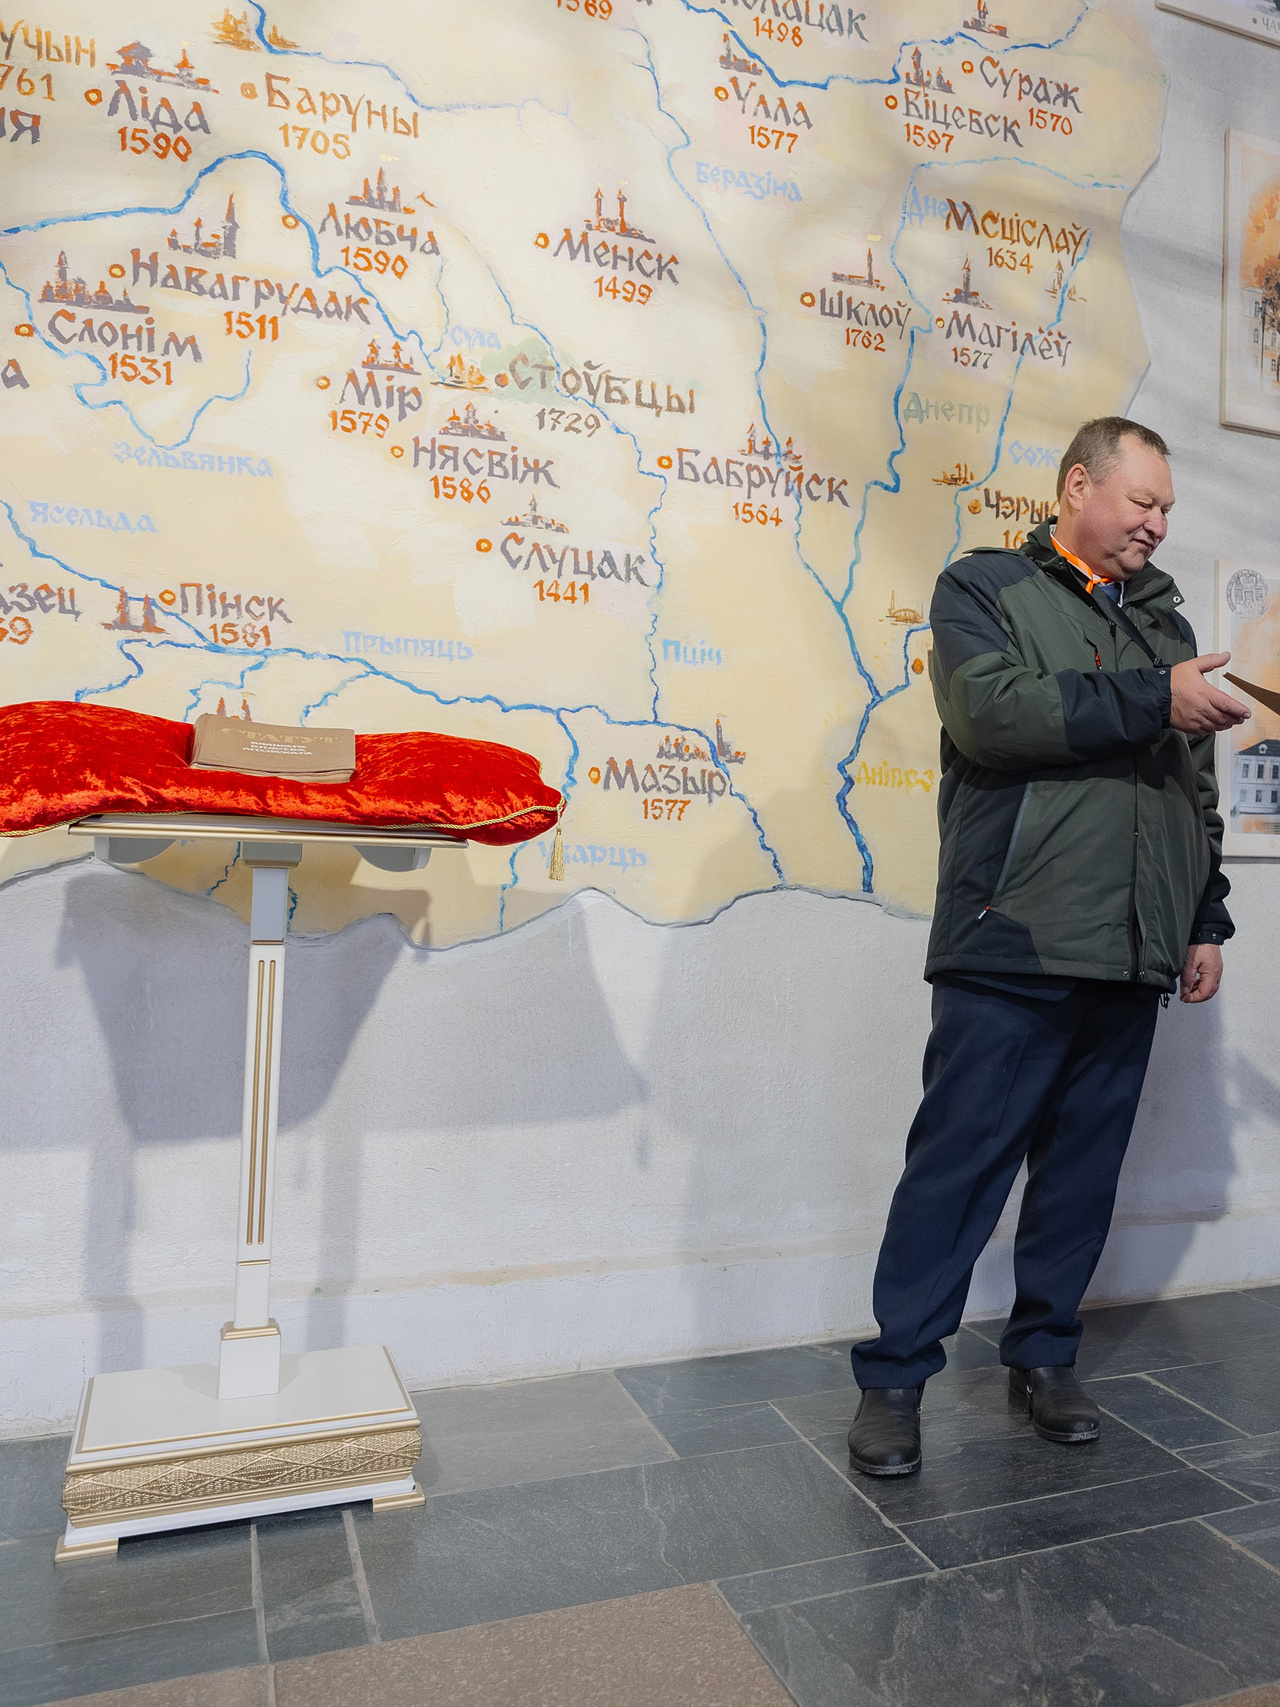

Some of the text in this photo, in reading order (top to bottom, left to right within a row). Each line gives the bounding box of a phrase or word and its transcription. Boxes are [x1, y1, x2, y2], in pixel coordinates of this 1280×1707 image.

[753, 16, 803, 48] 1498
[730, 75, 813, 130] Улла
[979, 55, 1083, 113] Сураж
[107, 80, 211, 135] Ліда
[265, 72, 420, 139] Баруны
[902, 88, 1024, 147] Віцебск
[1028, 107, 1074, 137] 1570
[117, 125, 193, 162] 1590
[279, 123, 352, 160] 1705
[748, 125, 799, 154] 1577
[904, 122, 955, 154] 1597
[318, 202, 441, 256] Любча
[945, 198, 1090, 266] Мсціслаў
[341, 246, 409, 280] 1590
[553, 229, 680, 285] Менск
[987, 246, 1033, 274] 1634
[131, 249, 371, 325] Навагрудак
[594, 275, 654, 305] 1499
[223, 311, 280, 342] 1511
[820, 287, 912, 340] Шклоў
[47, 308, 203, 362] Слонім
[845, 328, 887, 353] 1762
[945, 310, 1072, 367] Магілёў
[108, 352, 174, 386] 1531
[952, 347, 993, 370] 1577
[339, 369, 424, 421] Мір
[506, 352, 696, 418] Стоўбцы
[535, 407, 601, 436] 1729
[903, 391, 990, 434] Днепр
[113, 439, 274, 477] Зельвянка
[412, 434, 560, 489] Нясвіж
[429, 474, 491, 505] 1586
[675, 447, 851, 508] Бабруйск
[732, 501, 783, 527] 1564
[500, 532, 651, 587] Слуцак
[180, 583, 293, 624] Пінск
[533, 579, 590, 605] 1441
[341, 629, 474, 663] Прыпяць
[221, 727, 339, 744] СТАТУТ
[603, 756, 727, 805] Мазыр
[641, 798, 691, 821] 1577
